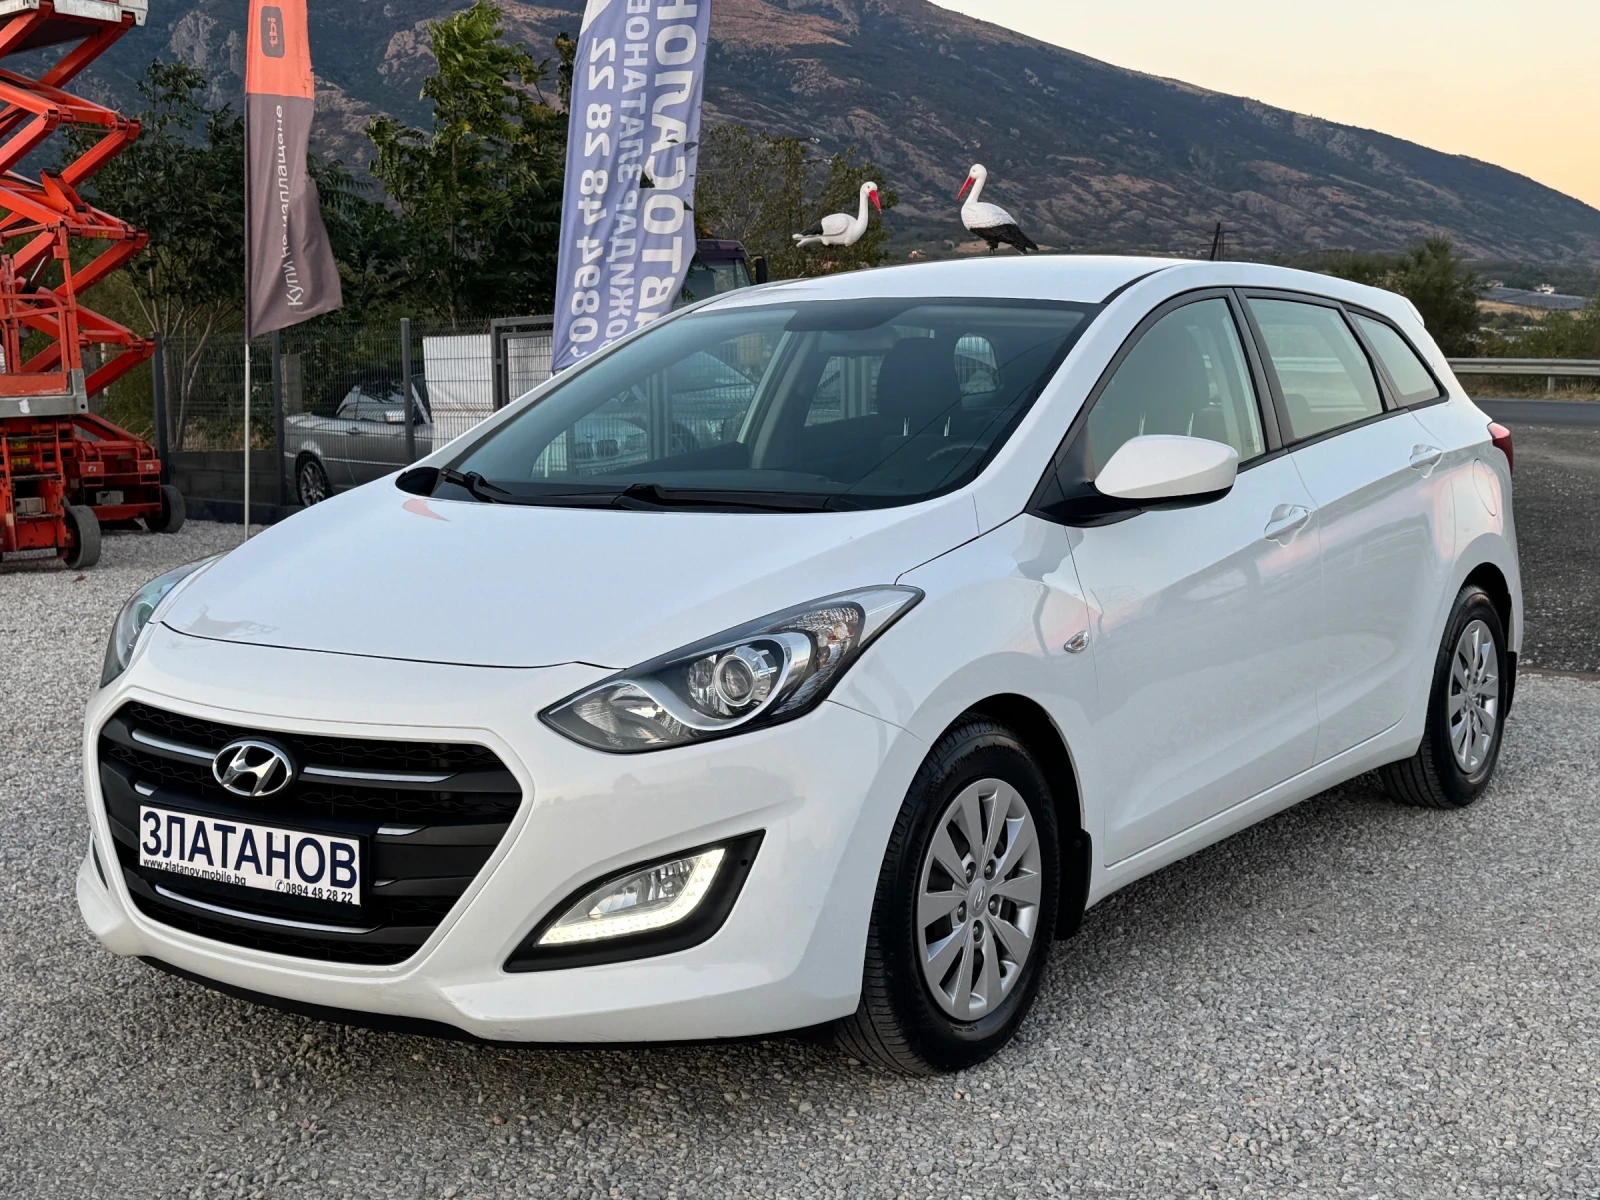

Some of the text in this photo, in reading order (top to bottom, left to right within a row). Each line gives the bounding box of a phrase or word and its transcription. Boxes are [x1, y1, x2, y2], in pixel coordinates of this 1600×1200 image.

[281, 260, 304, 306] Купи
[142, 811, 358, 889] ЗЛАТАНОВ
[143, 858, 246, 886] www.zlatanov.mobile.bg
[286, 882, 353, 904] 0894 48 28 22
